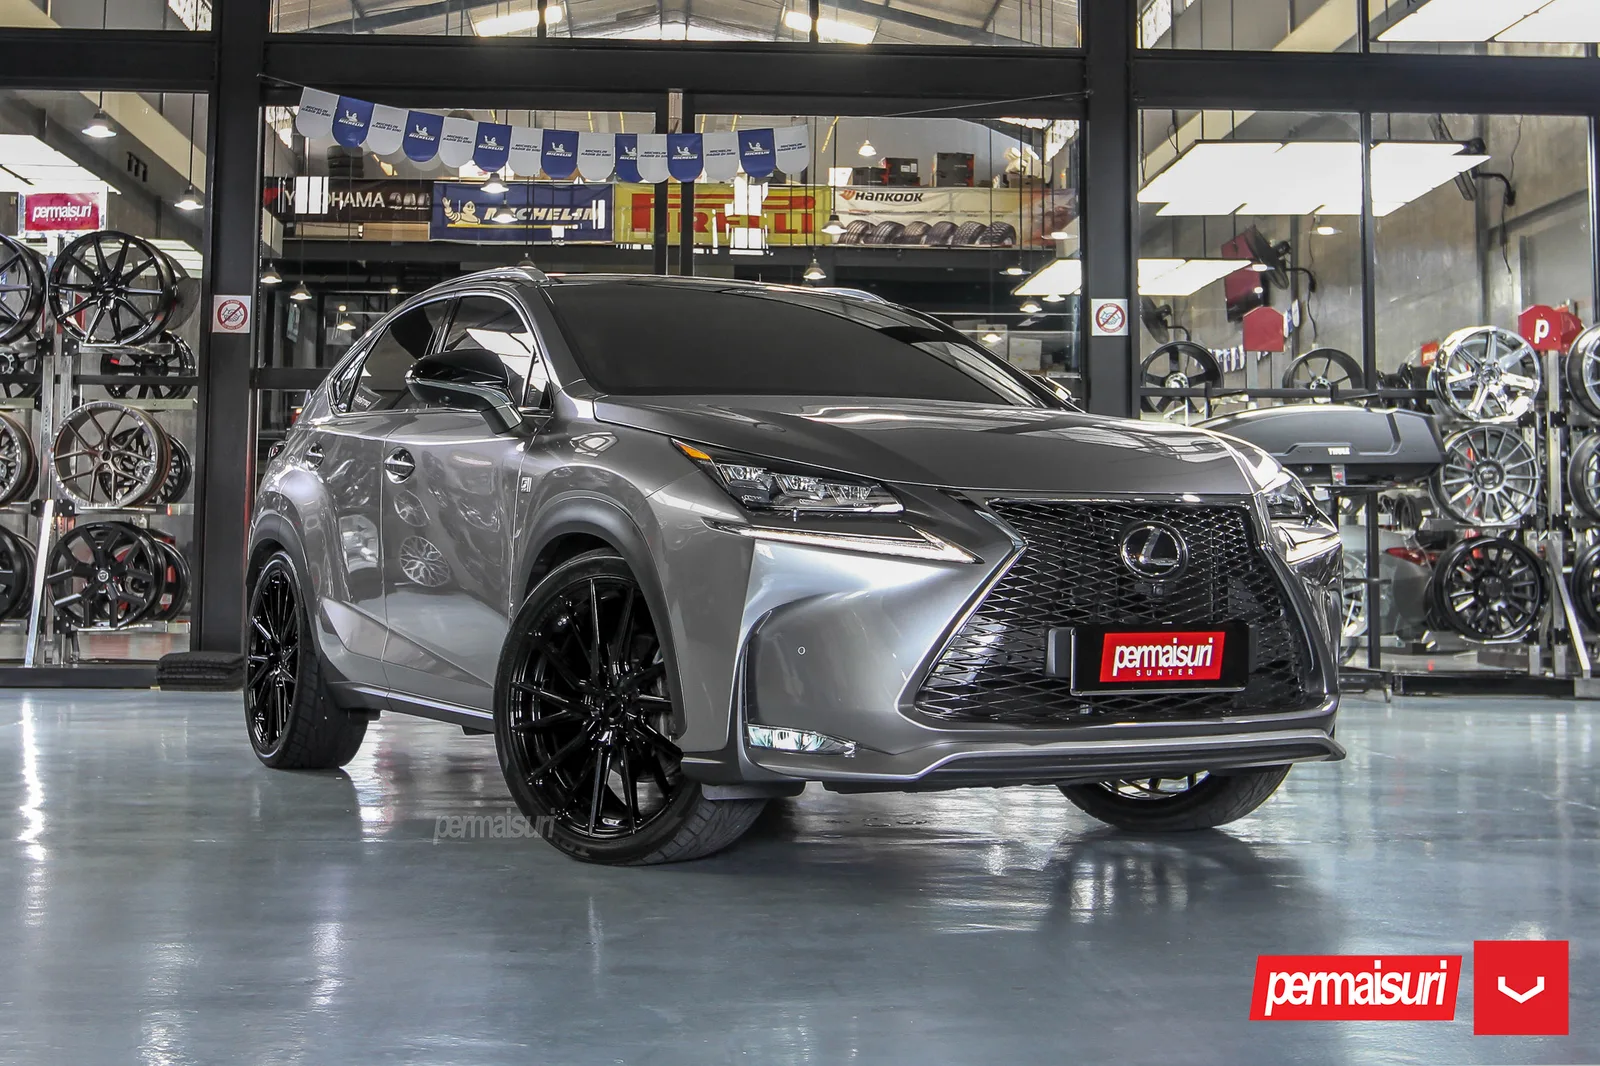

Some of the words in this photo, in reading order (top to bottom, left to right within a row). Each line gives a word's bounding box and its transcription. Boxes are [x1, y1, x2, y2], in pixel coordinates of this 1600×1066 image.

[338, 118, 364, 128] MICHELIN
[408, 133, 435, 142] MICHELIN
[285, 190, 386, 208] YHAMA
[32, 202, 92, 222] permaisuri
[484, 207, 601, 221] MCHELIN
[632, 193, 816, 234] PRELLI
[1112, 637, 1213, 676] permaisuri
[1136, 669, 1194, 677] SUNTER
